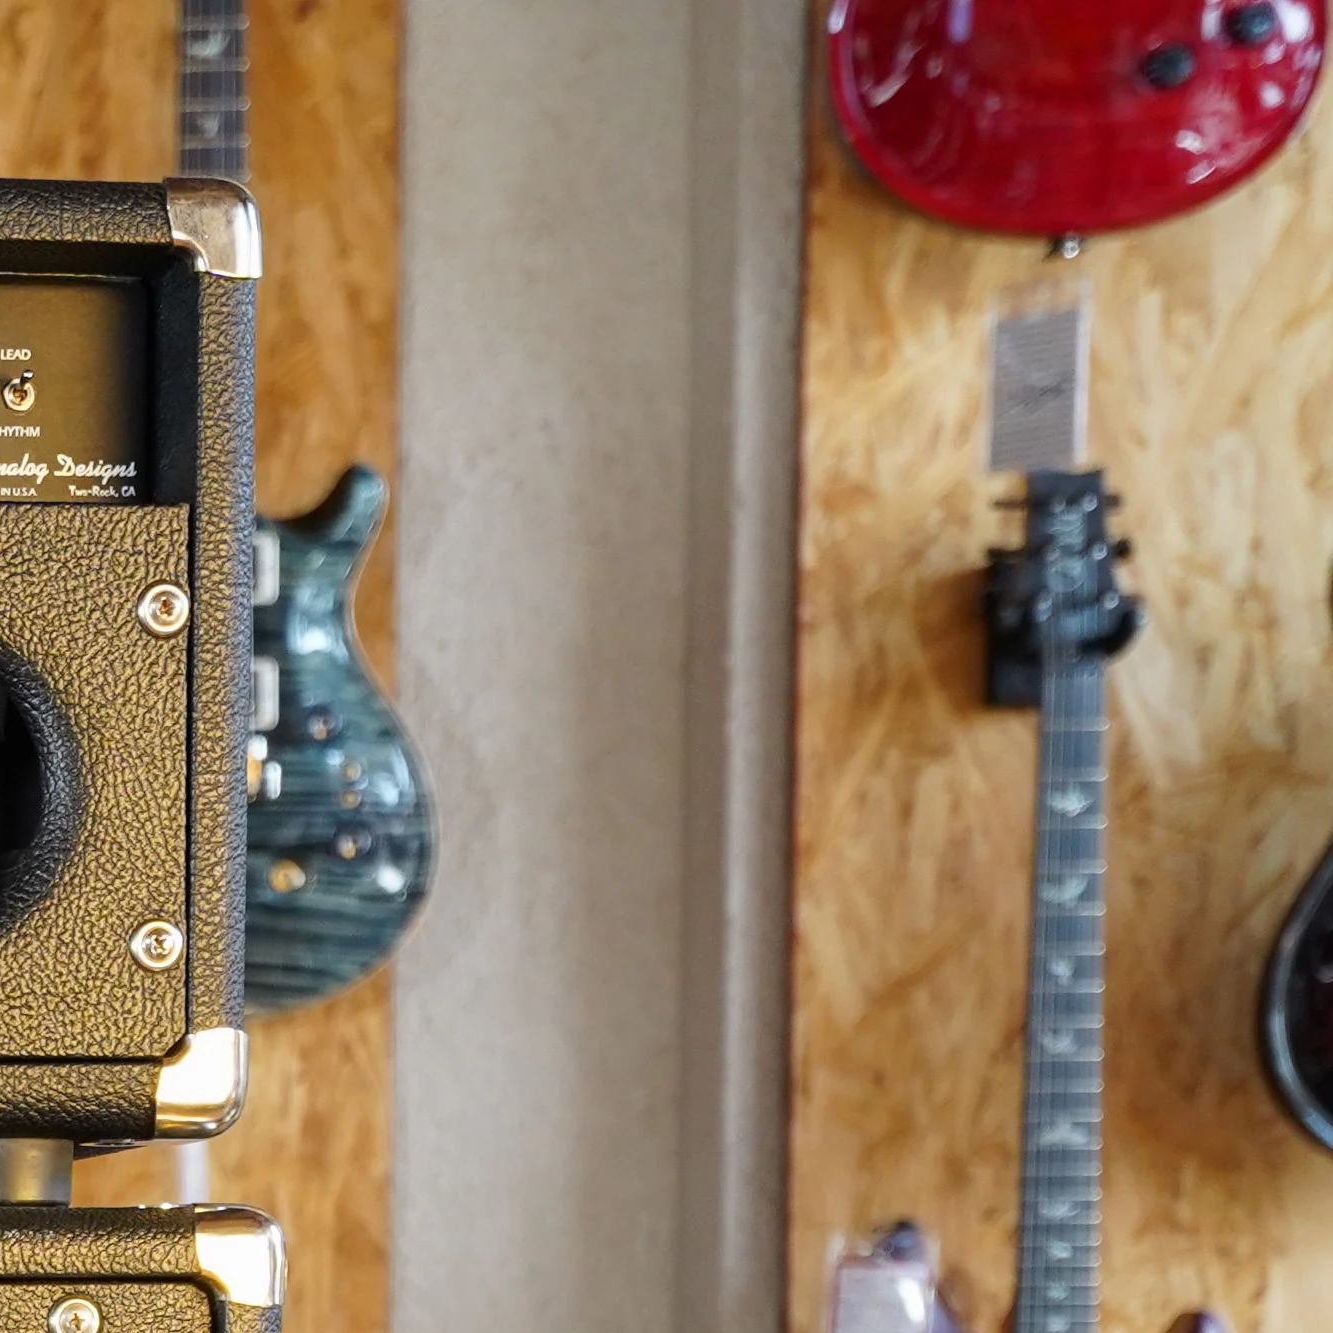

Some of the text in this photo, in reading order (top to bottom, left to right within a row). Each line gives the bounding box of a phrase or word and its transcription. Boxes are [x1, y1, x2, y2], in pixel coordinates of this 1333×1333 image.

[0, 348, 32, 361] LEAD
[54, 454, 137, 480] Designs
[1, 487, 12, 497] IN
[68, 485, 136, 498] Two-Rock, CA
